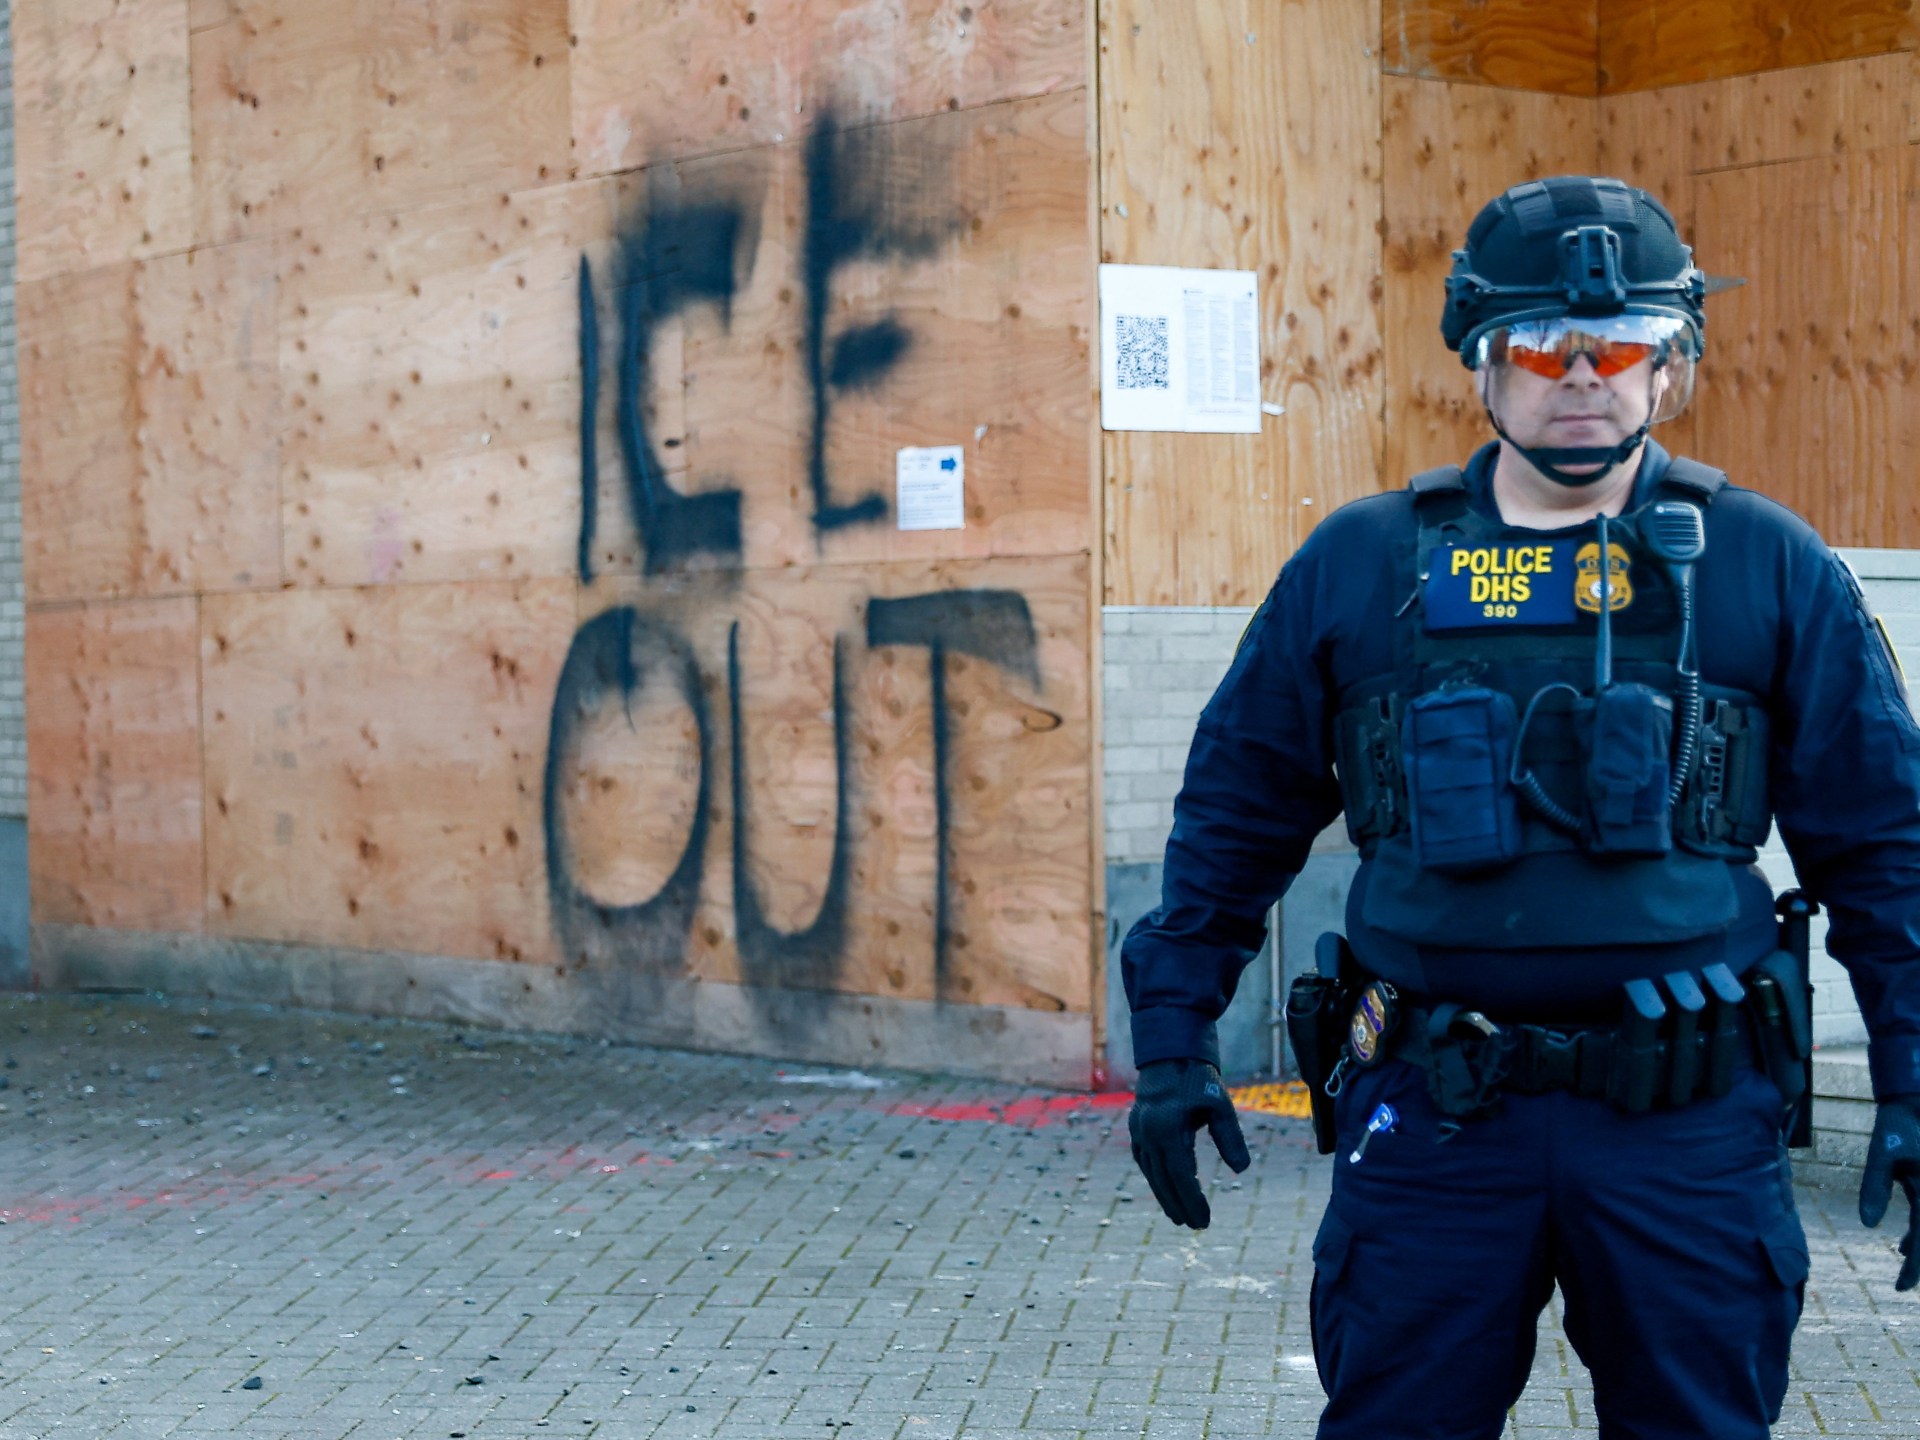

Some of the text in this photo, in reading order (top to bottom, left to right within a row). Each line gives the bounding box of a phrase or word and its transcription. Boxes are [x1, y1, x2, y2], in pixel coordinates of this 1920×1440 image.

[577, 104, 958, 584] ICE
[1451, 546, 1553, 576] POLICE
[1586, 558, 1621, 571] DS
[1470, 575, 1531, 603] DHS
[1483, 604, 1518, 618] 390
[543, 589, 1042, 1010] OUT
